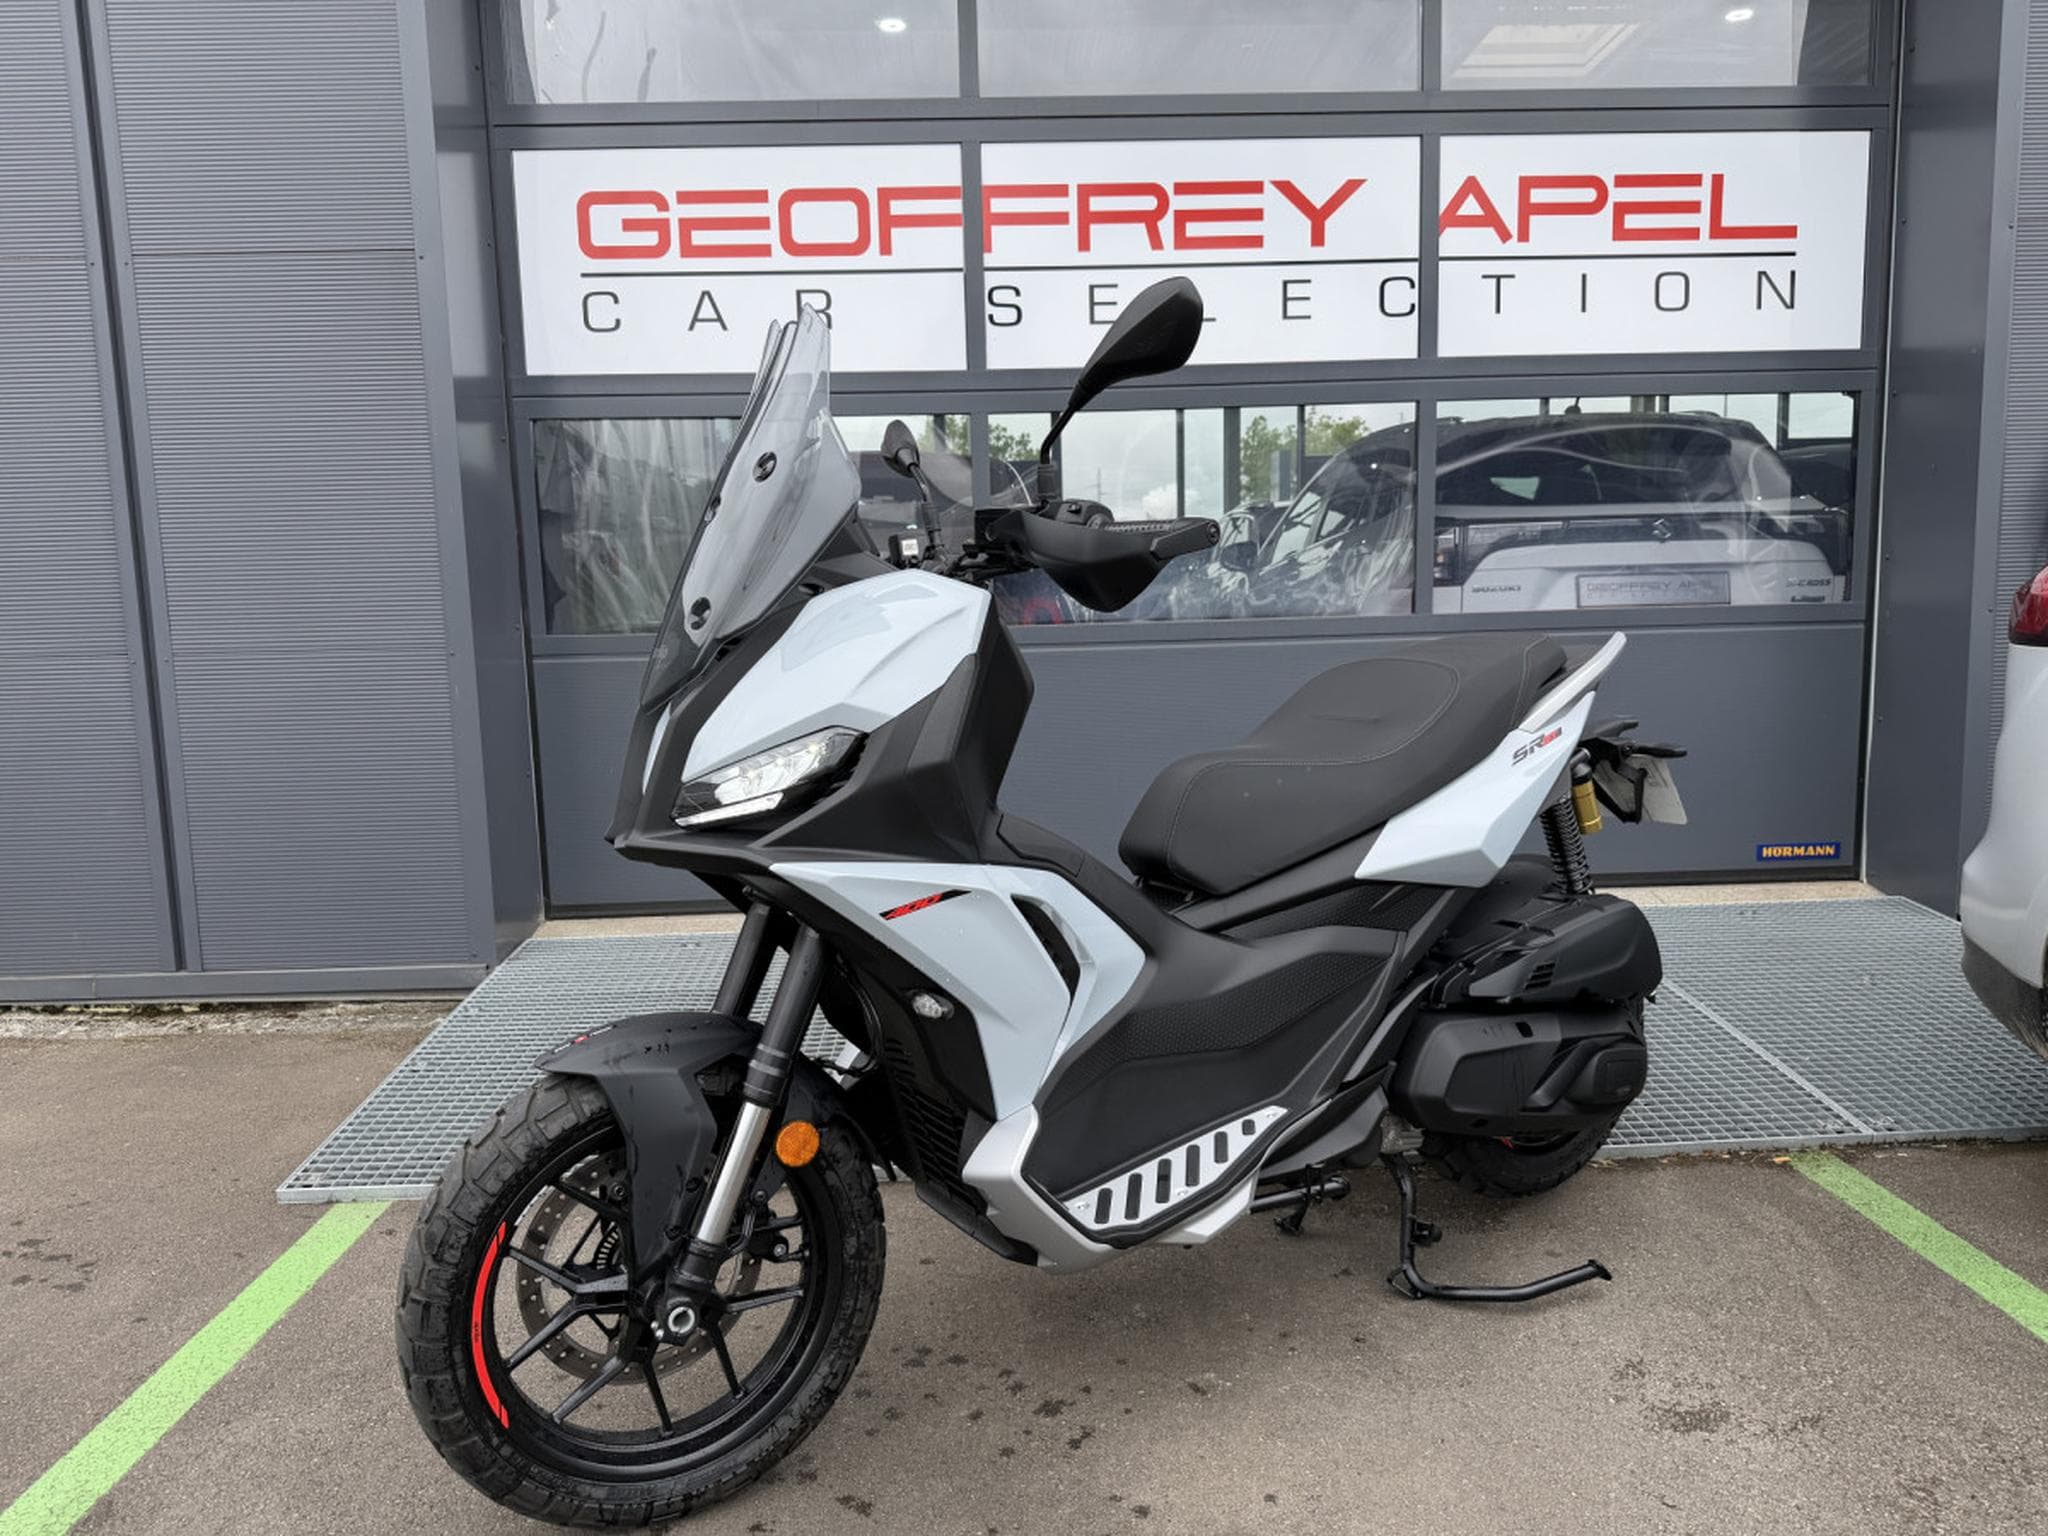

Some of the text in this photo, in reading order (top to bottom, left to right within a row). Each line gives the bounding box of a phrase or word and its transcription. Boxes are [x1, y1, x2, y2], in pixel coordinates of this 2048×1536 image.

[576, 173, 1798, 260] GEOFFREY APEL
[582, 270, 1797, 333] CAR SEECTION
